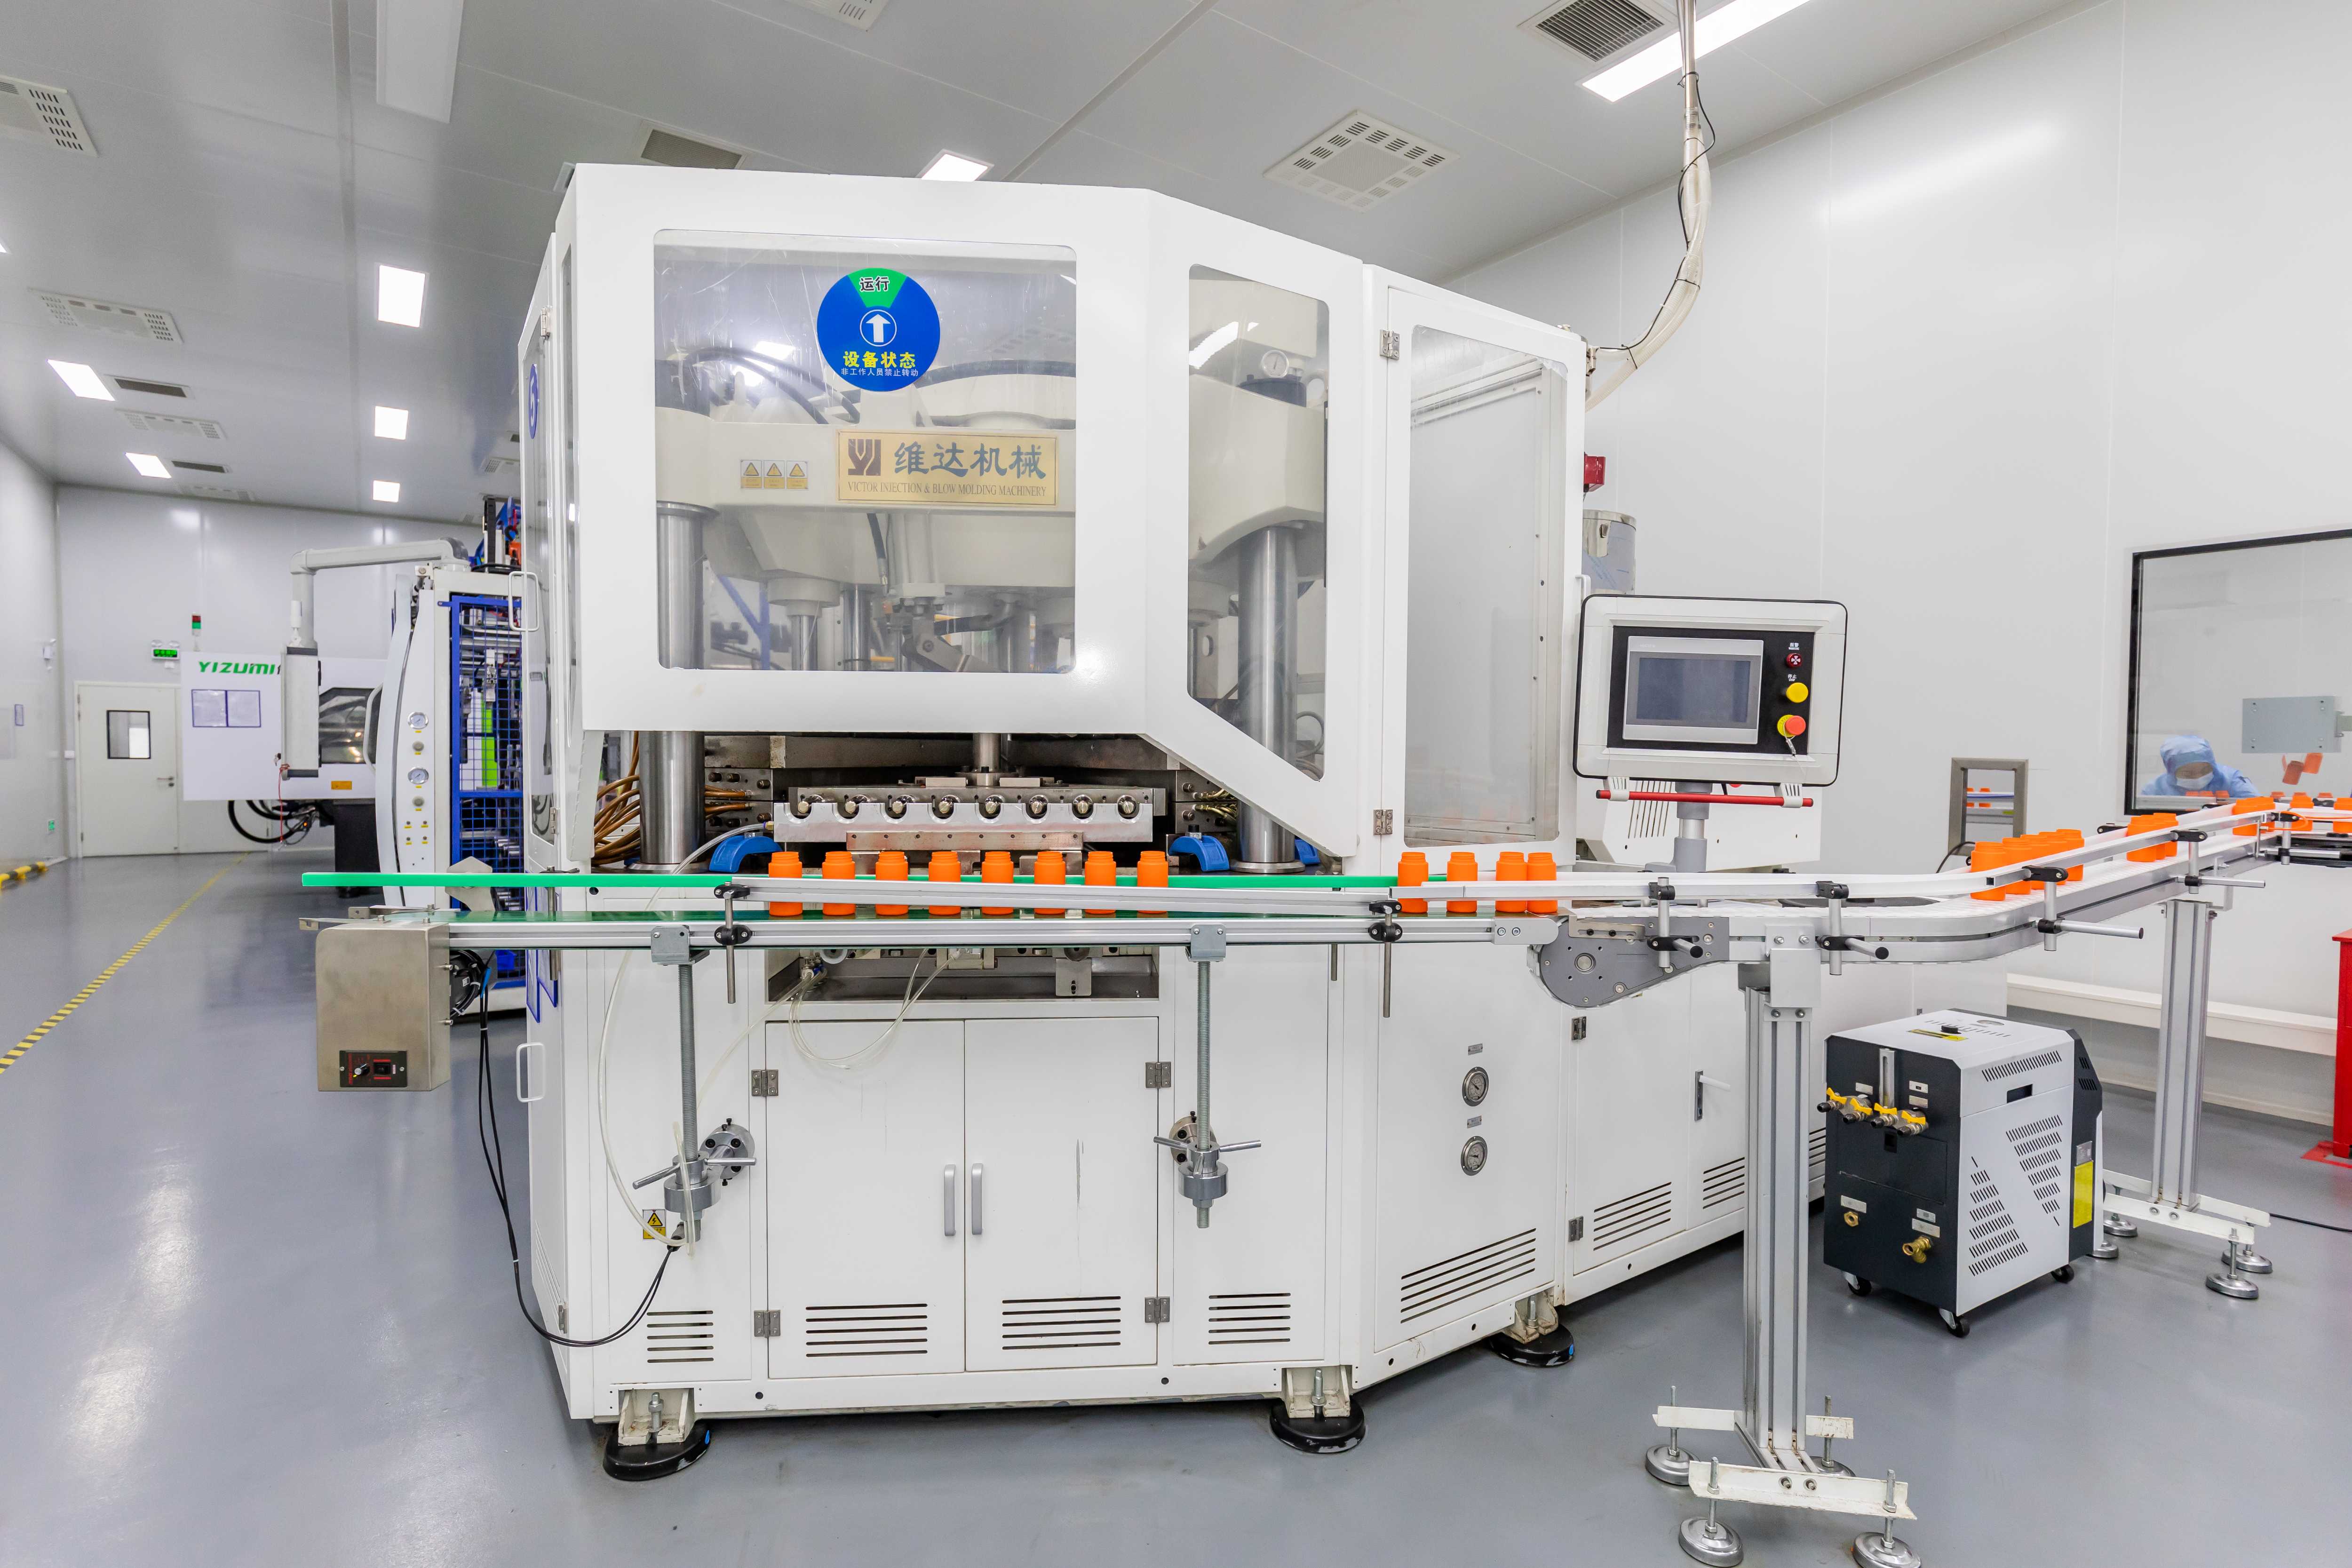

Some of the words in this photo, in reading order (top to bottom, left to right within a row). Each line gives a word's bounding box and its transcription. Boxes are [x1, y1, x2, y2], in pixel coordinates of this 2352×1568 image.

[859, 276, 890, 292] 运行
[843, 351, 916, 368] 设备状态
[841, 368, 918, 377] 非工作人员禁止转动
[530, 376, 535, 426] 5
[894, 441, 1047, 479] 维达机械
[848, 481, 878, 492] VICTOR
[881, 482, 922, 493] INJECTION
[924, 484, 930, 493] &
[933, 483, 956, 494] BLOW
[959, 484, 996, 495] MOLDING
[999, 486, 1047, 497] MACHINERY
[199, 661, 275, 675] YIZUMI
